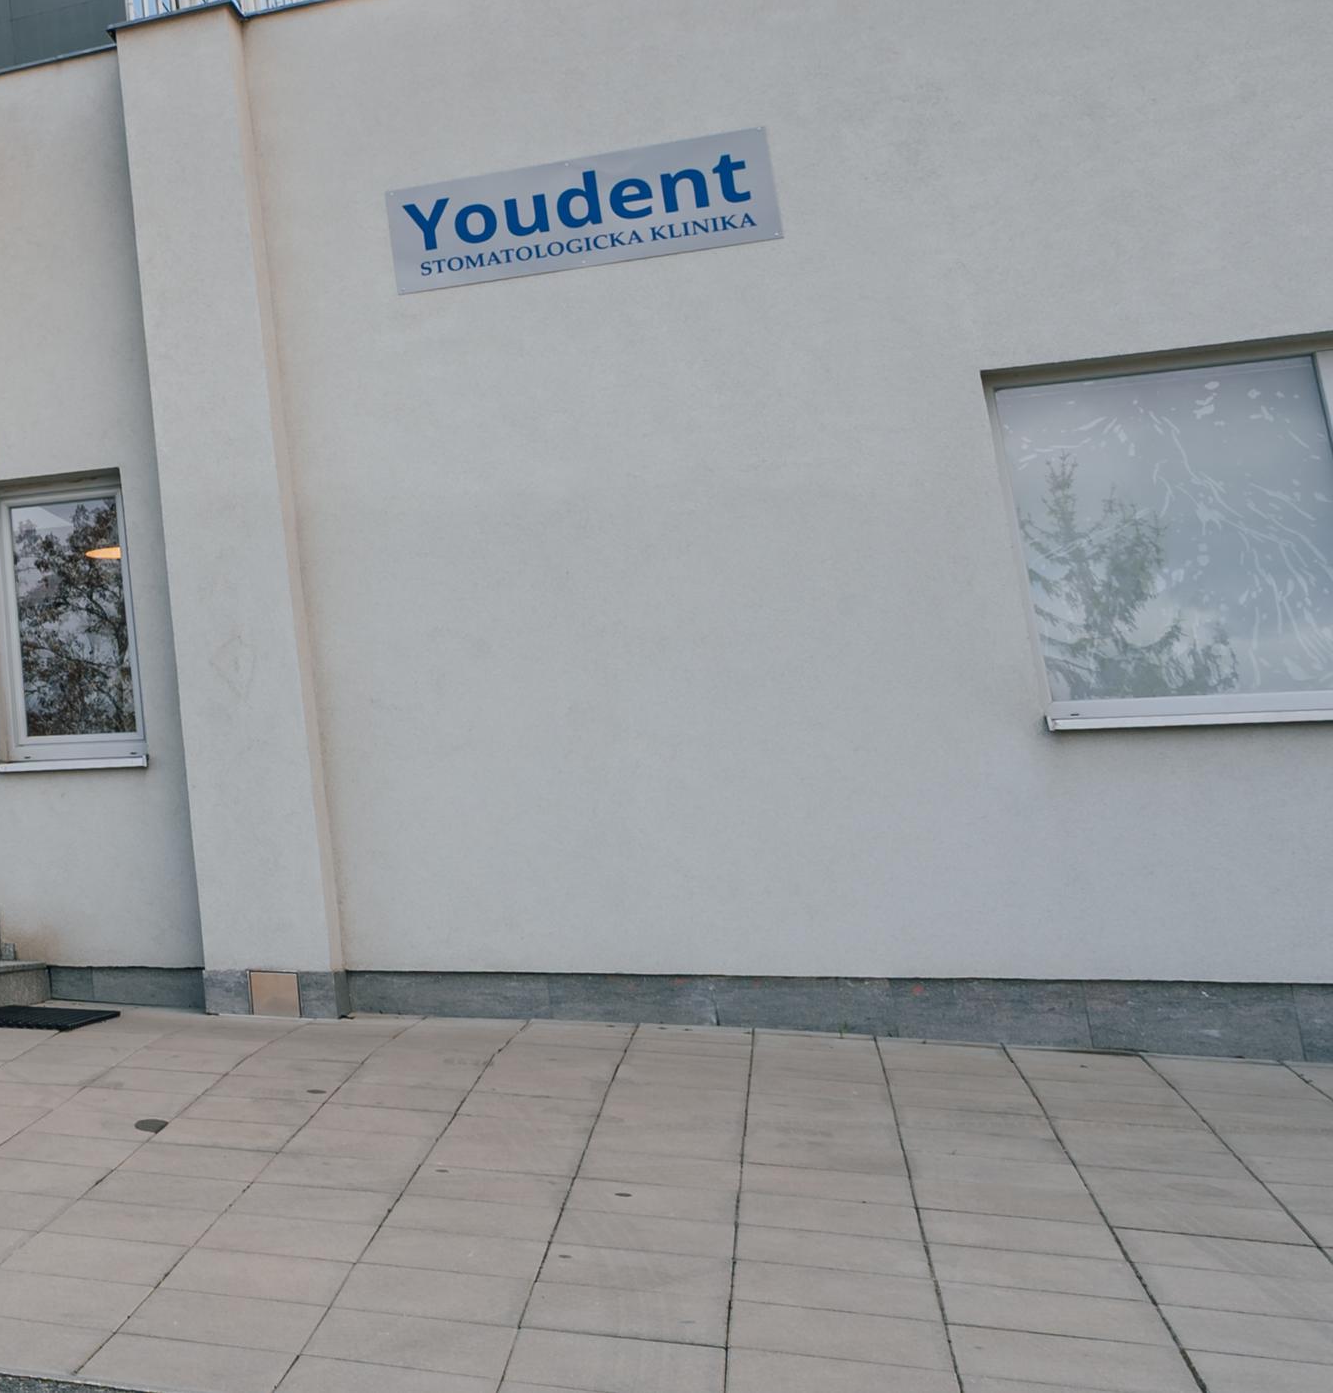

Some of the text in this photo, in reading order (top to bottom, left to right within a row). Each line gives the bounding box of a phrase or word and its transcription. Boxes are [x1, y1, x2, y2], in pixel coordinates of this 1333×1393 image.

[402, 154, 751, 251] Youdent
[420, 212, 757, 277] STOMATOLOGICKA KLINIKA
